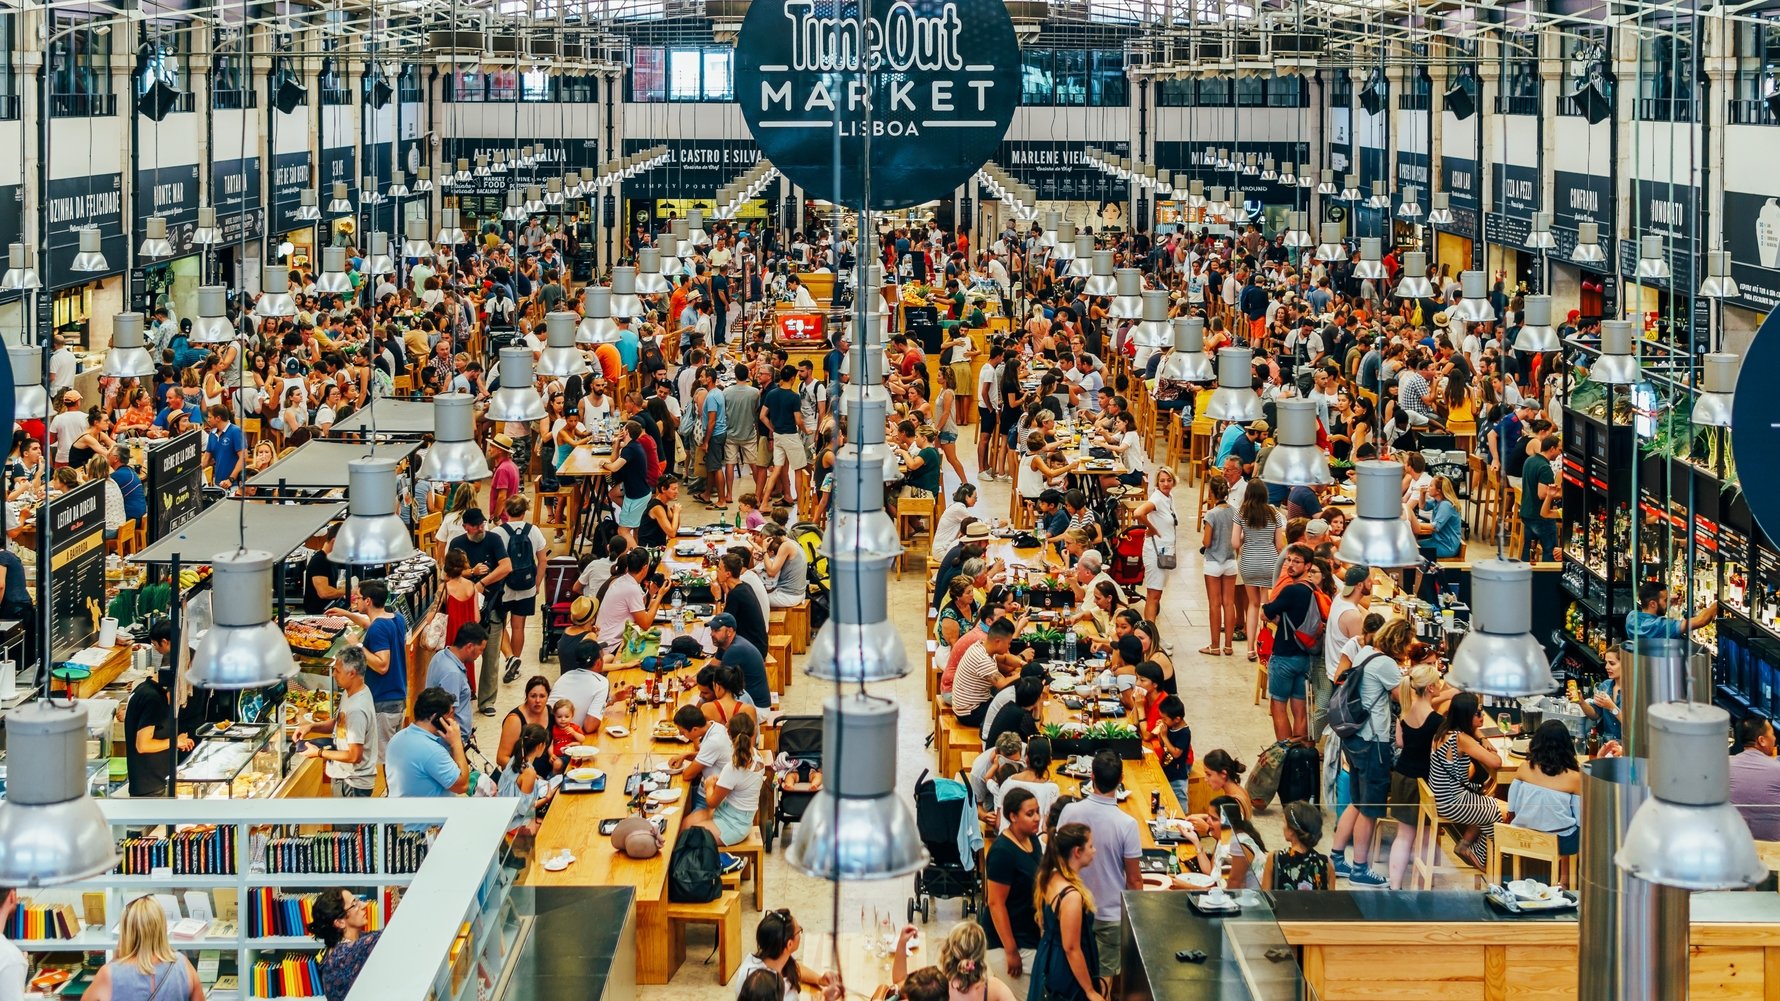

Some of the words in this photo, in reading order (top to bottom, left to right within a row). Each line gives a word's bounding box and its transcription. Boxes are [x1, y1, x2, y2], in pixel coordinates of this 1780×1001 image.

[760, 80, 995, 112] MARKET
[838, 120, 920, 137] LISBOA
[680, 149, 720, 163] CASTRO
[724, 149, 730, 163] E
[733, 149, 763, 163] SILVA
[1011, 150, 1059, 165] MARLENE
[172, 182, 184, 203] MAR
[1520, 180, 1532, 200] PEZZI
[1570, 188, 1598, 212] CONFRARIA
[76, 196, 85, 219] DA
[86, 190, 120, 217] FELICIDADE
[58, 506, 72, 530] LEITÃO
[73, 504, 79, 520] DA
[80, 496, 96, 516] RIBEIRA
